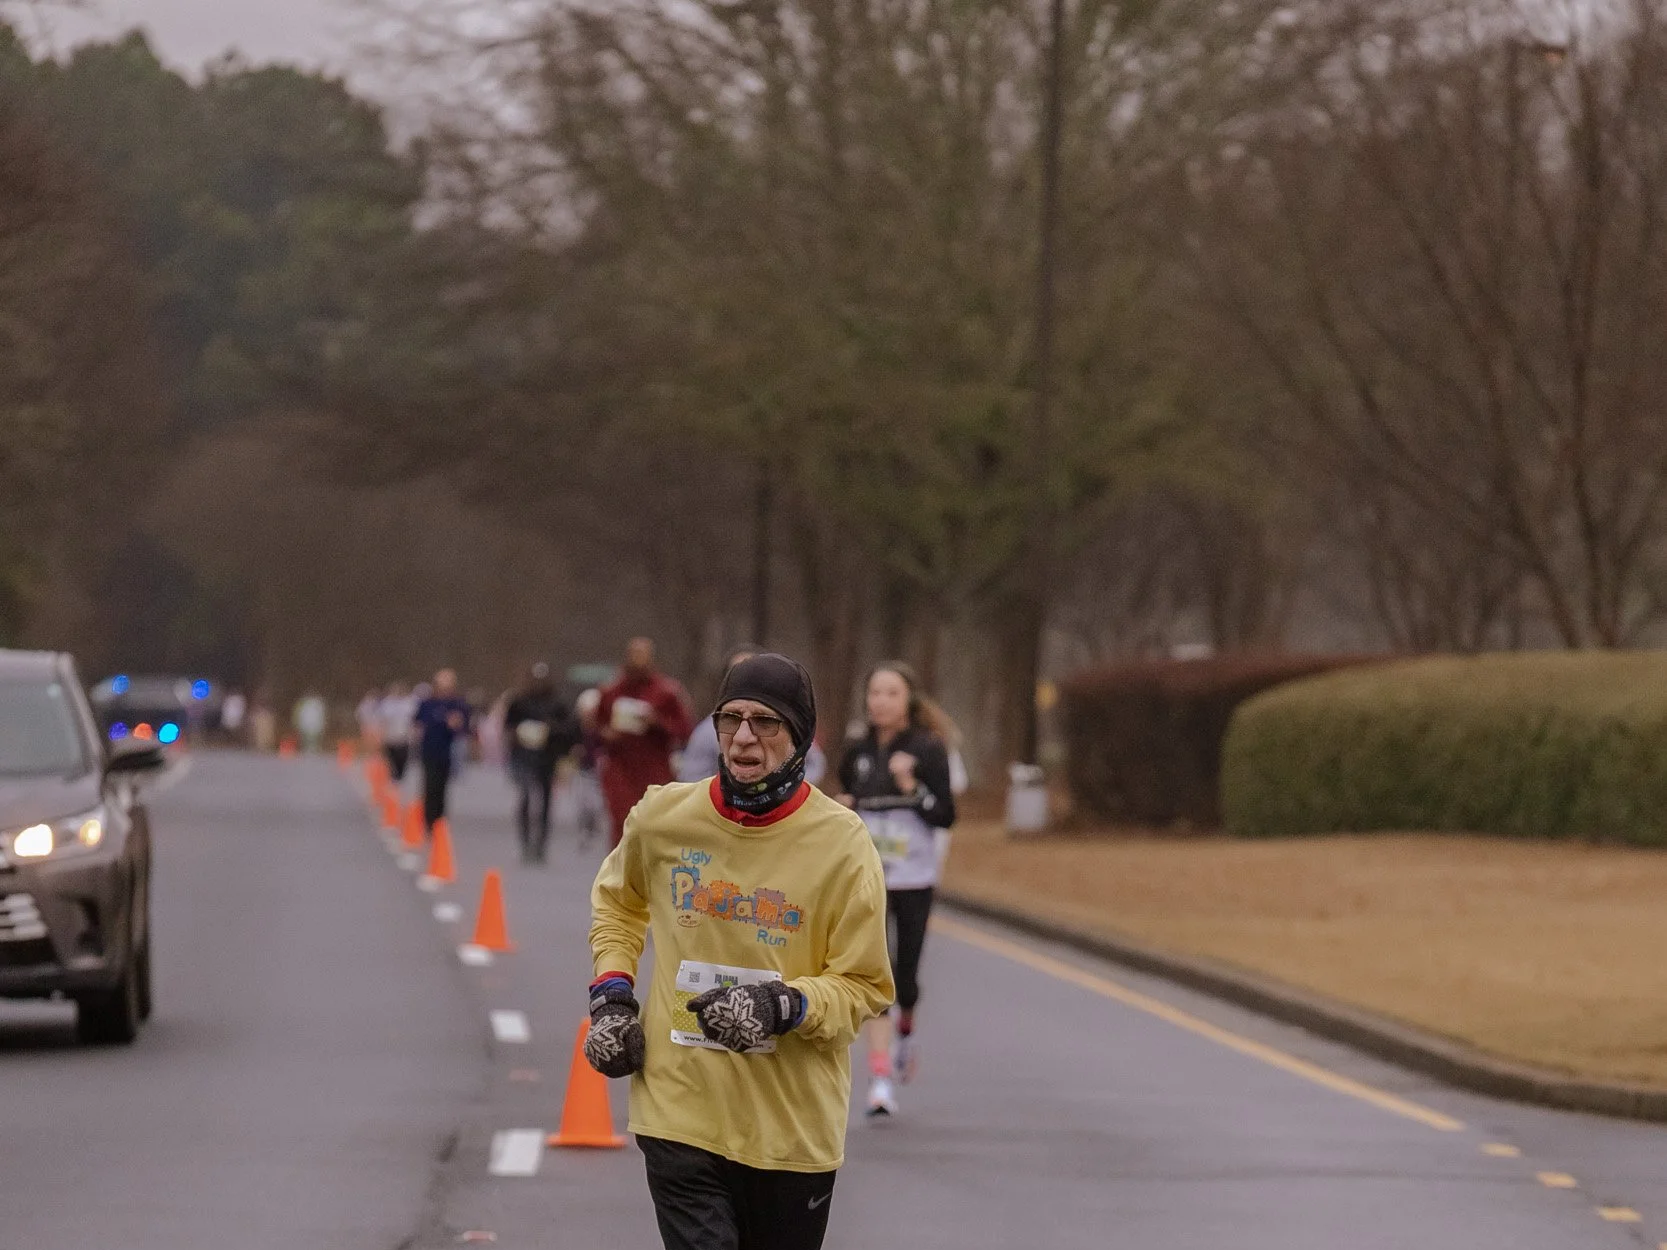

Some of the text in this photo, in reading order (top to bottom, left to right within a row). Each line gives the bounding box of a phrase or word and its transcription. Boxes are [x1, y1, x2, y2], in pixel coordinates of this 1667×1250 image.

[681, 848, 711, 866] Ugly
[673, 870, 802, 929] Pajama
[757, 930, 787, 947] Run
